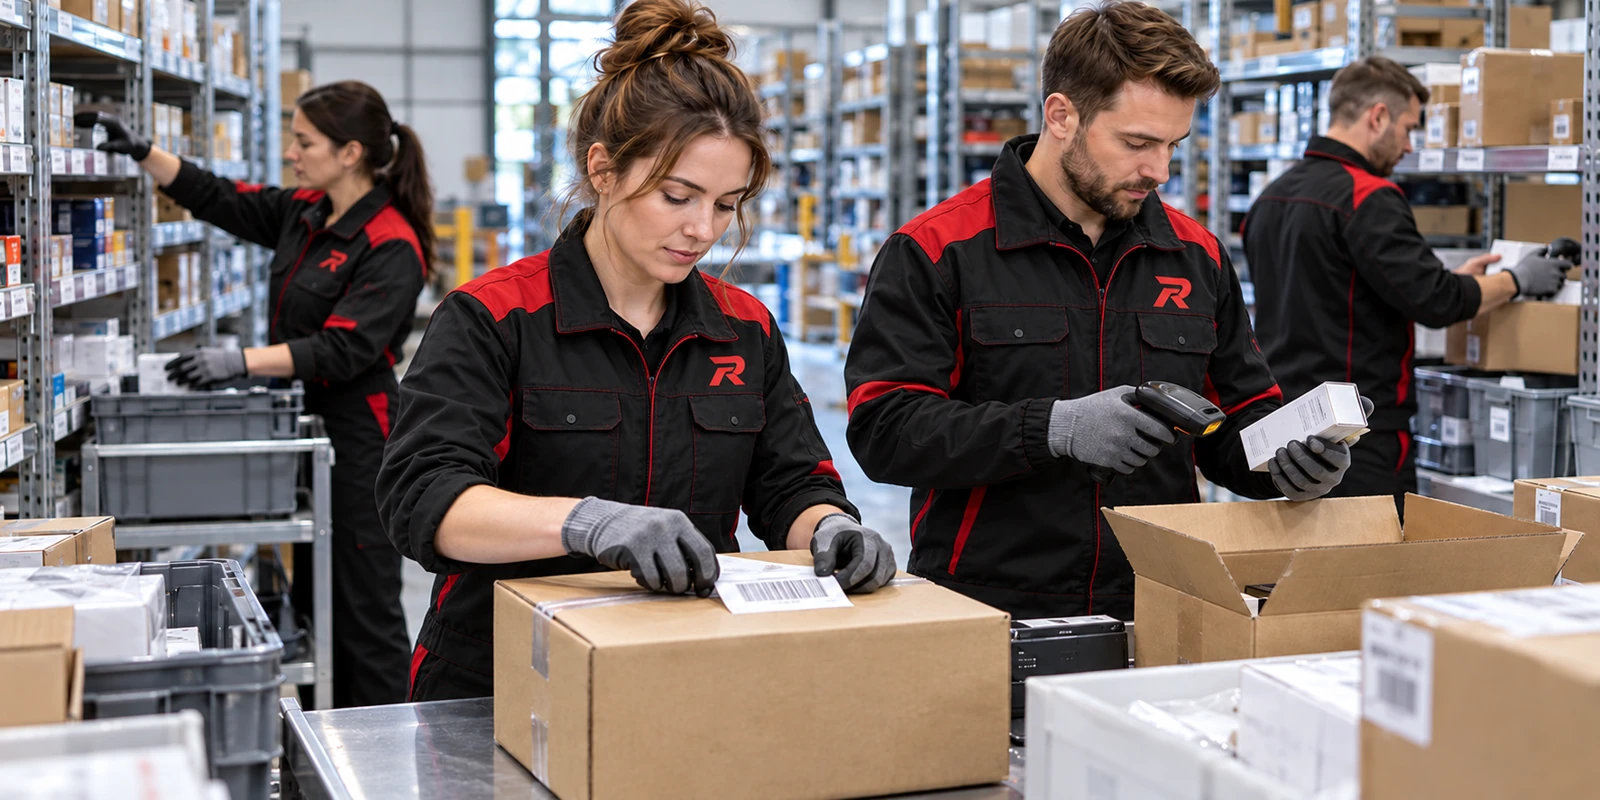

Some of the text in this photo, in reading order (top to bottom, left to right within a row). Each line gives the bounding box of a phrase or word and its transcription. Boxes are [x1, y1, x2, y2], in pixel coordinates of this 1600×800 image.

[319, 249, 348, 272] R
[1153, 275, 1191, 309] R
[709, 355, 745, 386] R
